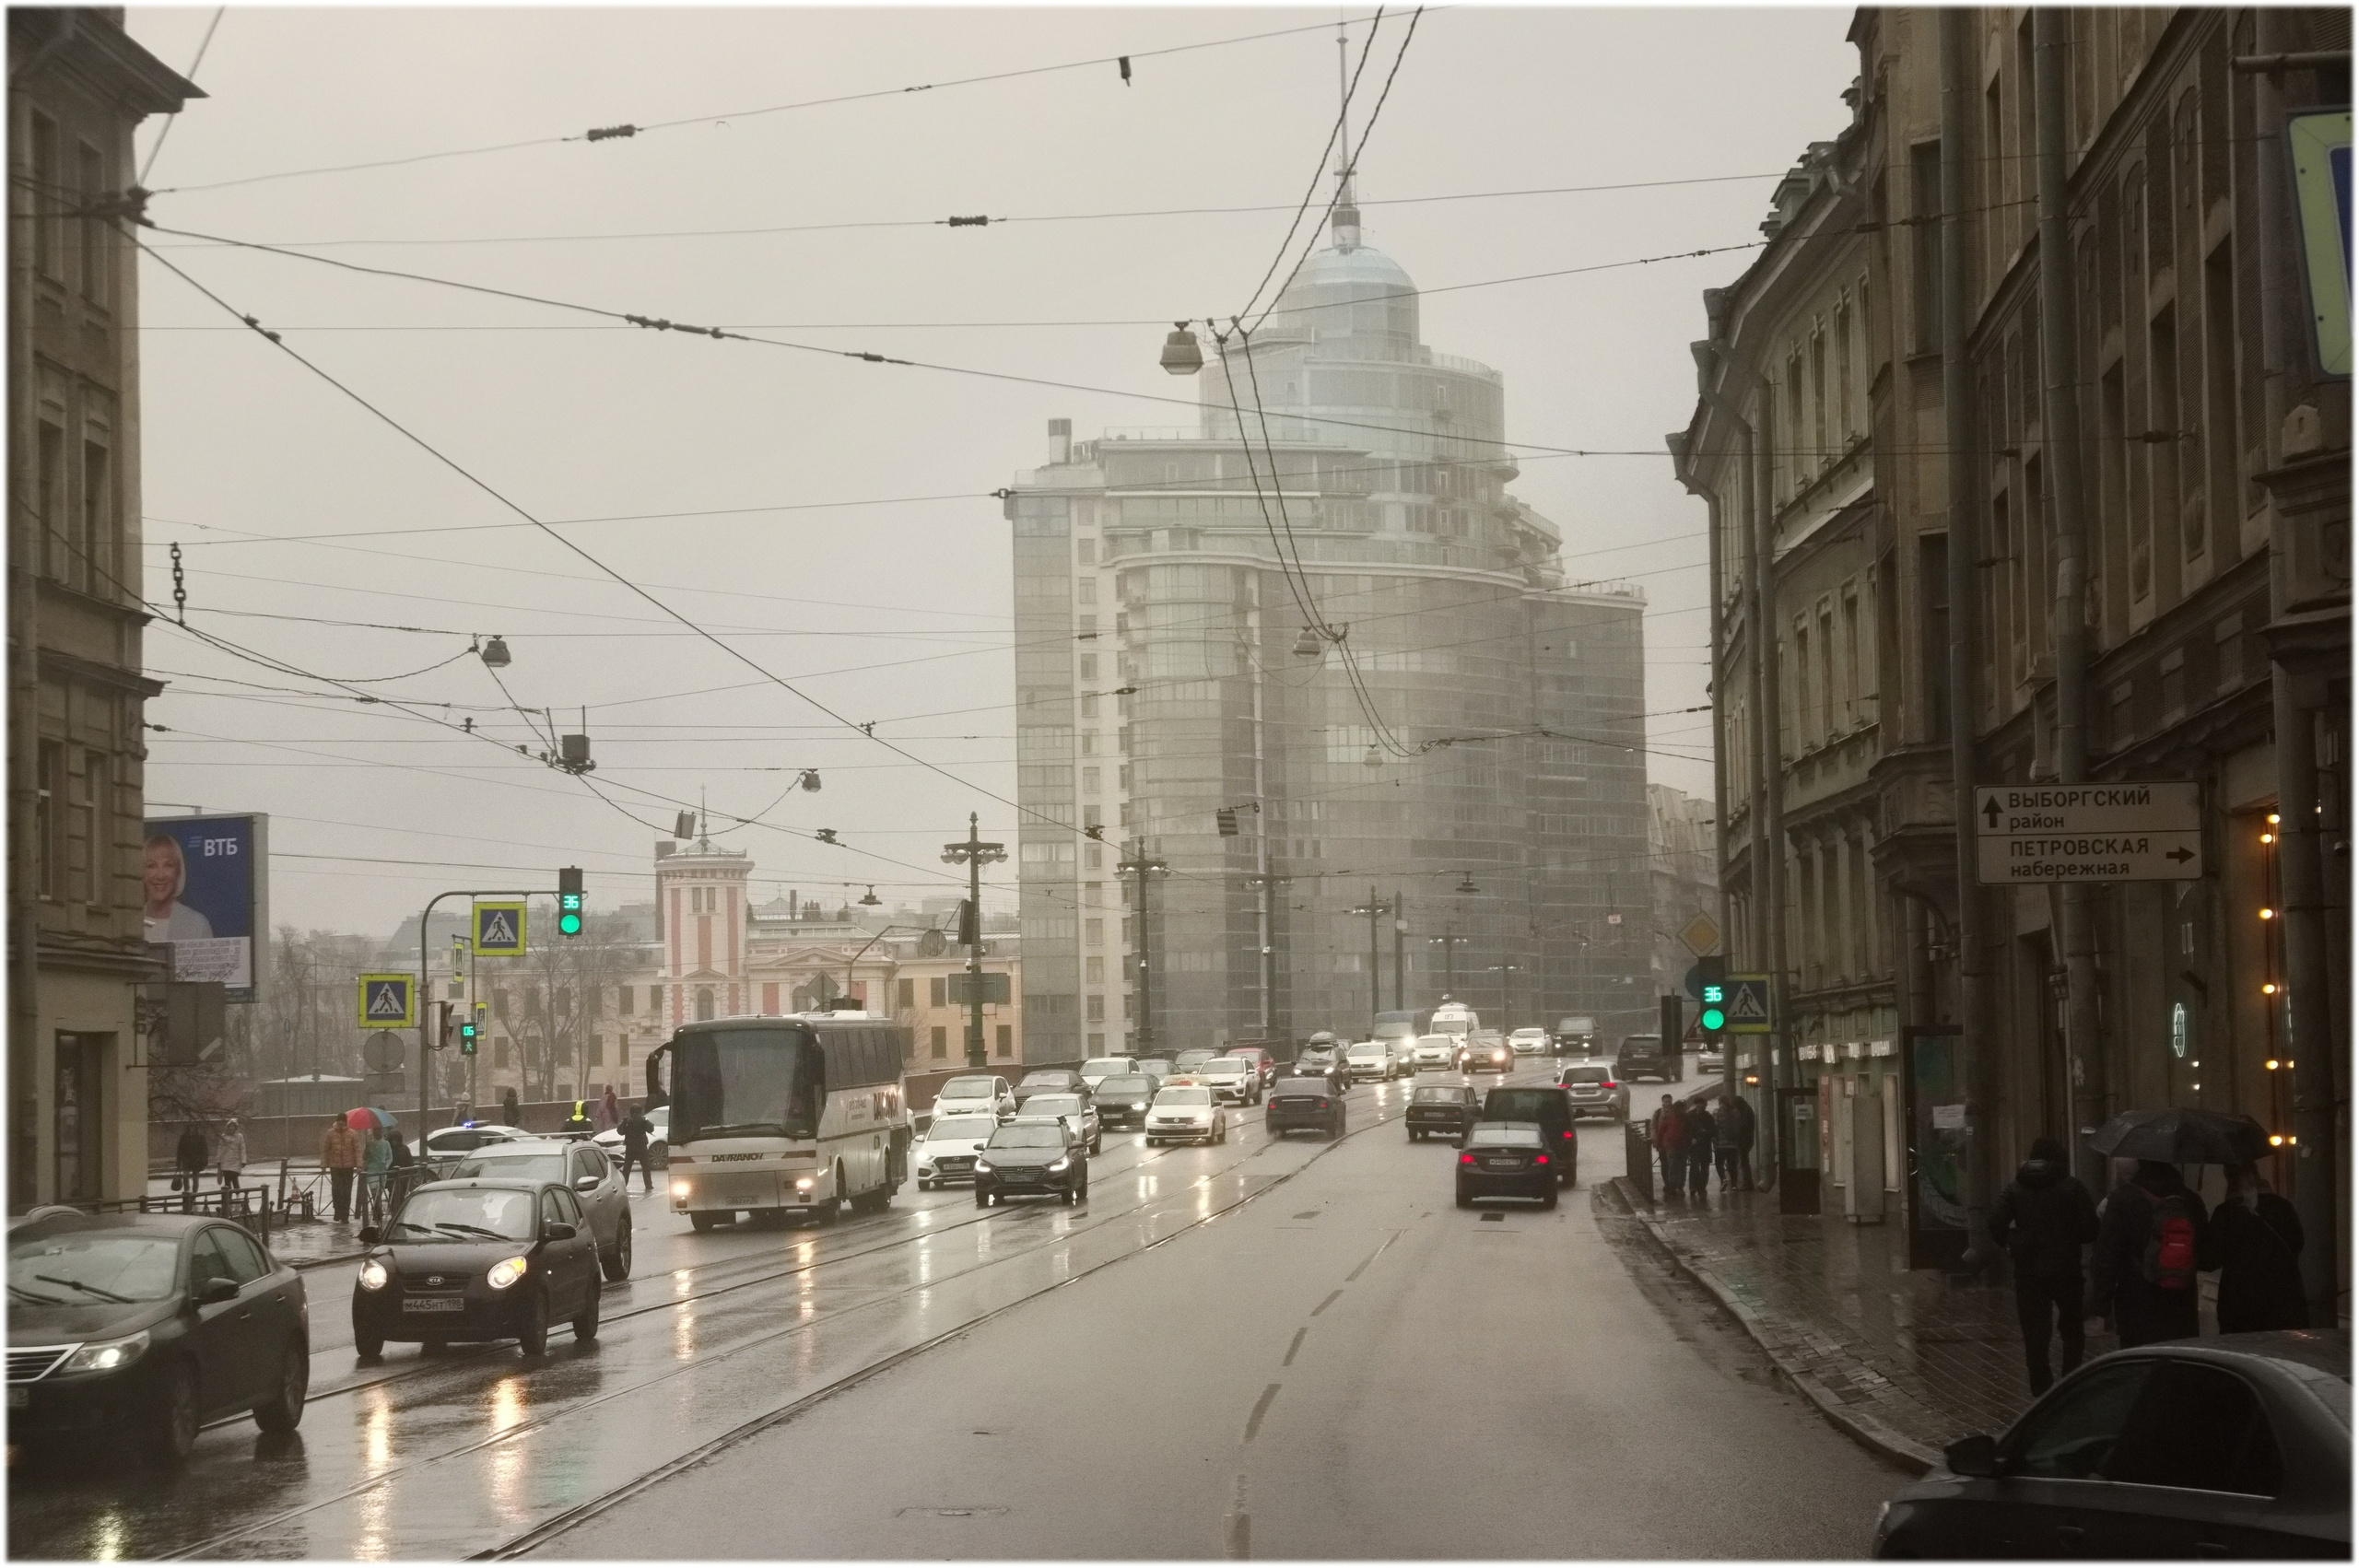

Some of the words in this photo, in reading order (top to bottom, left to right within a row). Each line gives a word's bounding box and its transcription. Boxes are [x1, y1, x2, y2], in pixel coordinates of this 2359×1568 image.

[2009, 785, 2151, 808] ВЫБОРГСКИЙ
[2010, 813, 2064, 832] район
[205, 837, 238, 856] ВТБ
[2011, 837, 2149, 857] ПЕТРОВСКАЯ
[2011, 860, 2130, 879] набережная
[564, 895, 579, 908] 36
[1705, 987, 1721, 1001] 36
